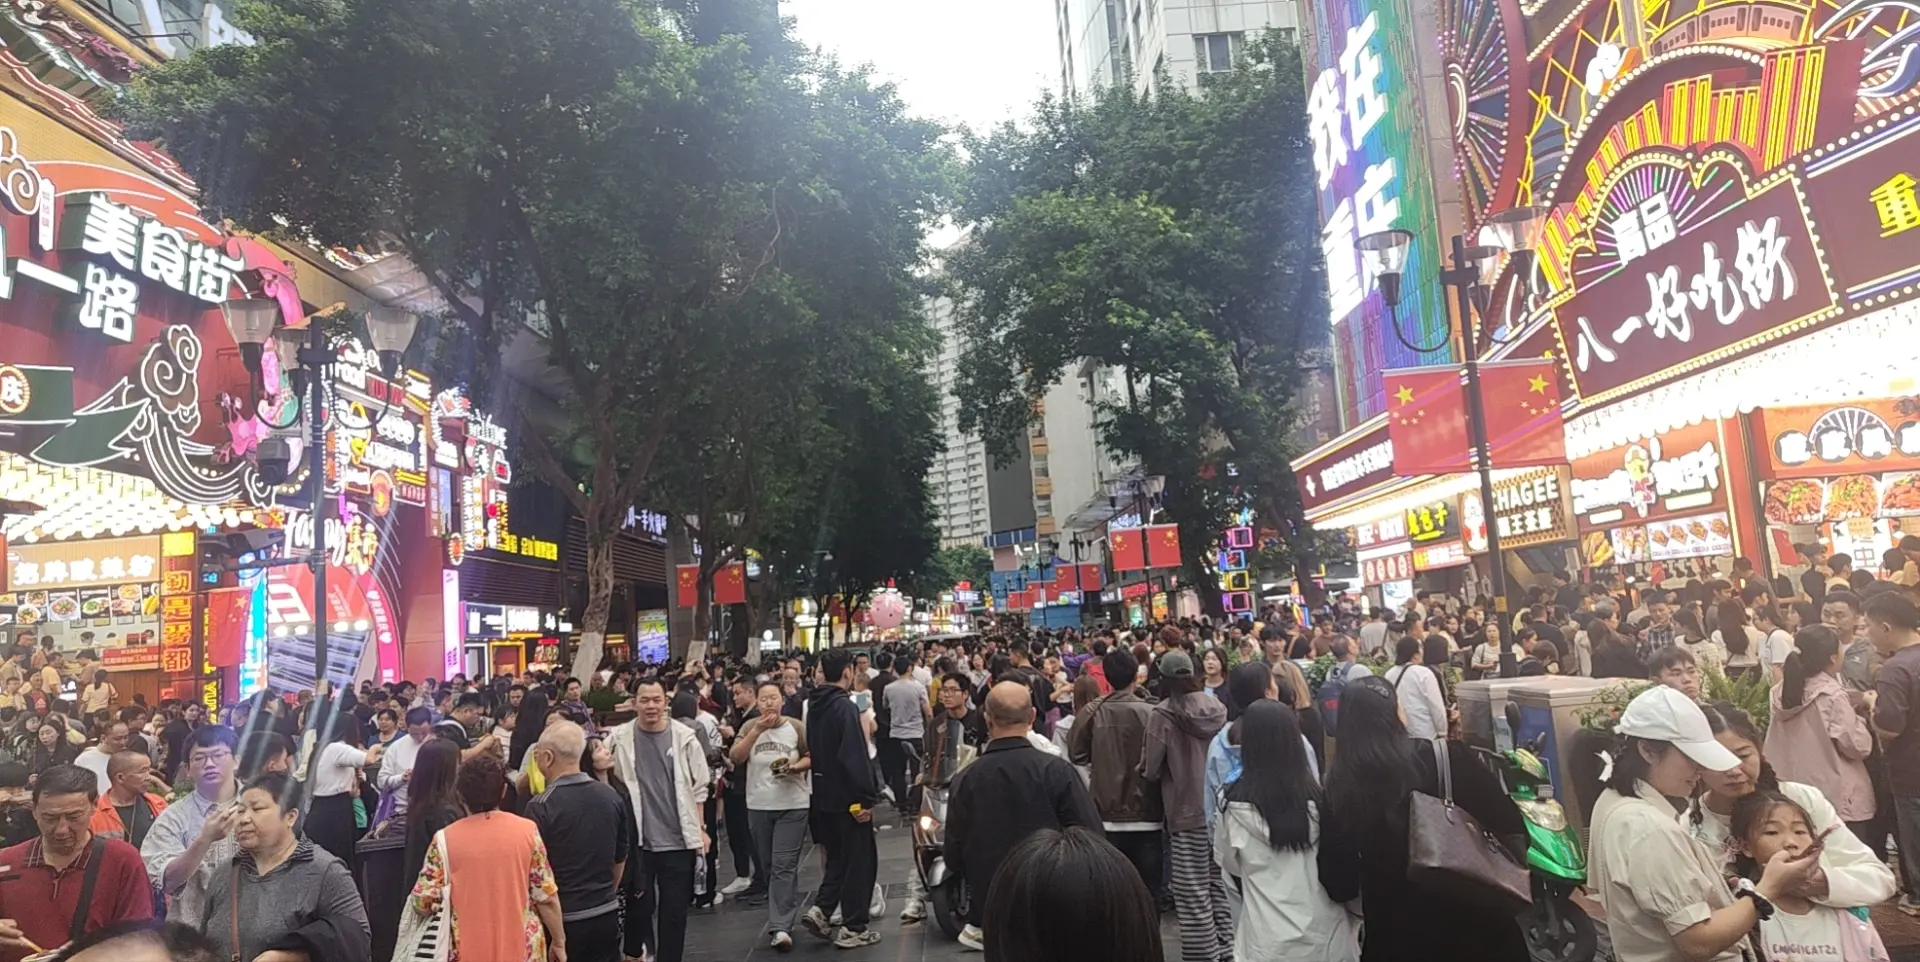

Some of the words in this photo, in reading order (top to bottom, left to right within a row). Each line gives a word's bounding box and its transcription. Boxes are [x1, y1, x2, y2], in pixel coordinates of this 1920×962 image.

[1307, 10, 1389, 191] 我在
[82, 192, 252, 304] 美食街
[1575, 216, 1796, 372] 八一好吃街
[1492, 474, 1559, 512] HAGEE
